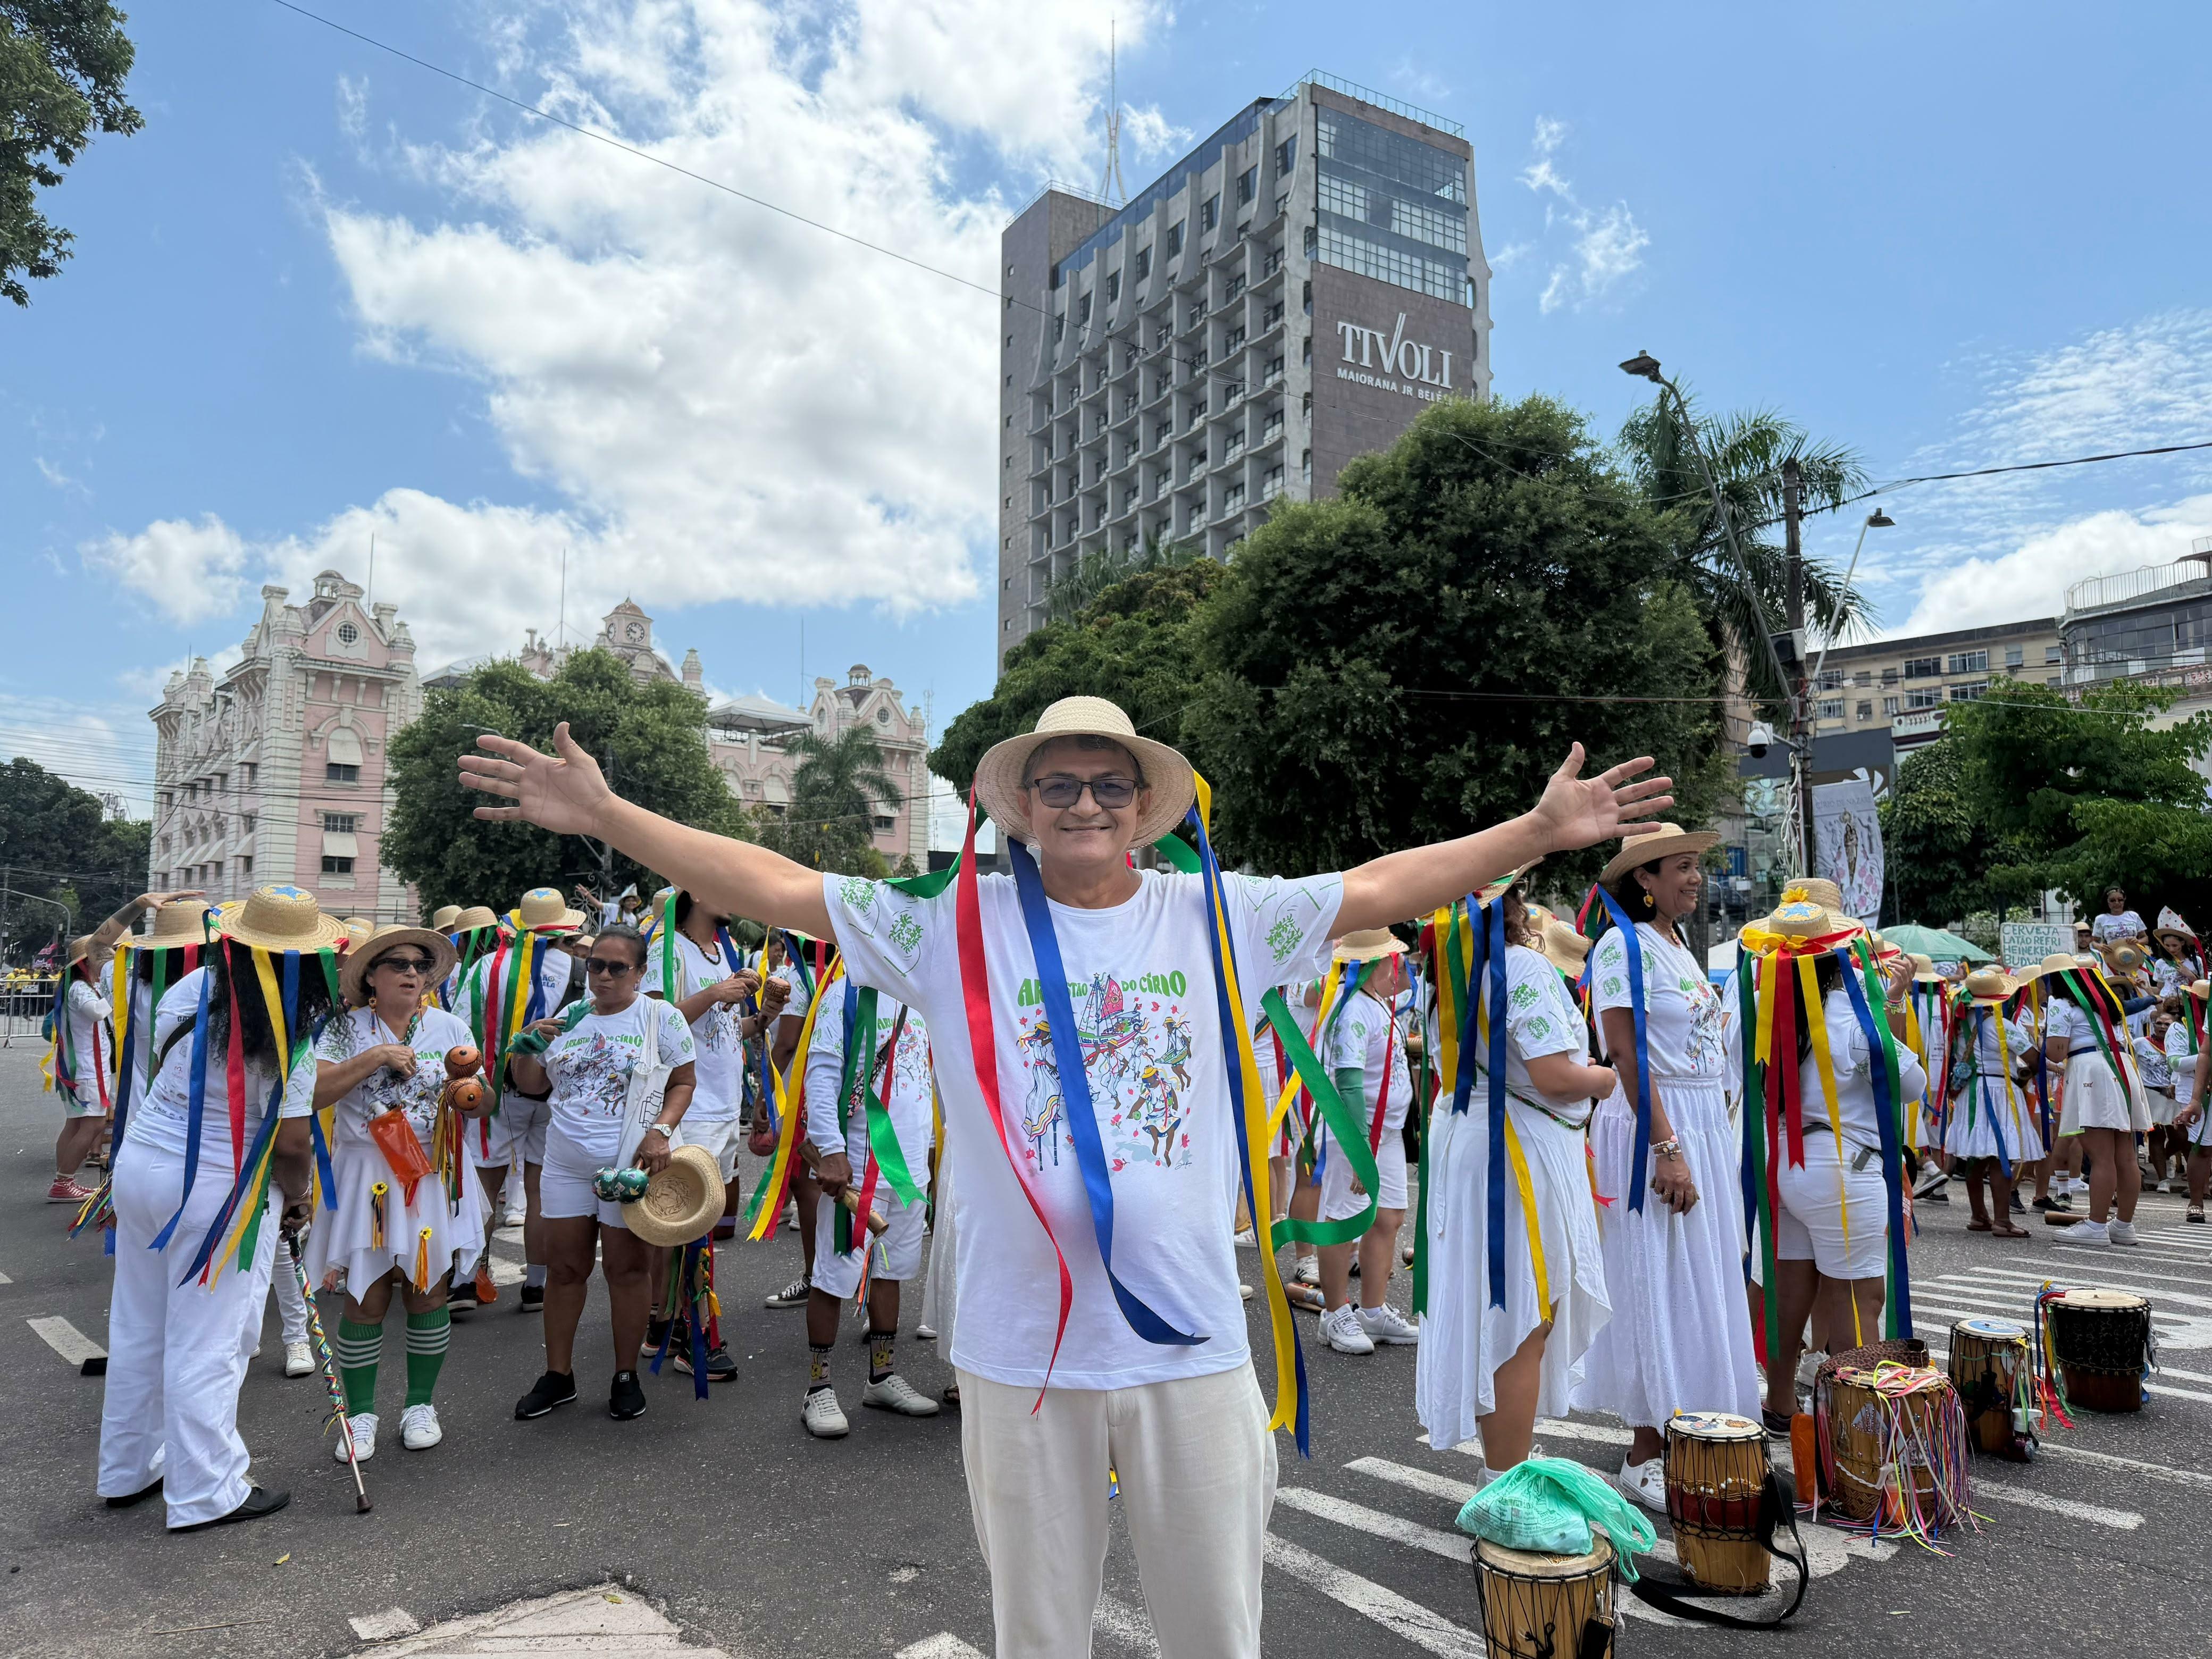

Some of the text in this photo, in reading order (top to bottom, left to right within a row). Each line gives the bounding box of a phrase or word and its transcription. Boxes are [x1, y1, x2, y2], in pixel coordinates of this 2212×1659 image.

[1337, 312, 1453, 389] TIVOLI
[1337, 367, 1397, 392] MAIORANA
[1401, 384, 1413, 397] JR
[2002, 924, 2059, 936] CERVEJA
[2004, 945, 2052, 956] HEINEKEN
[2034, 936, 2060, 946] REFRI
[1121, 979, 1137, 992] DO
[1139, 970, 1186, 998] CÍRIO
